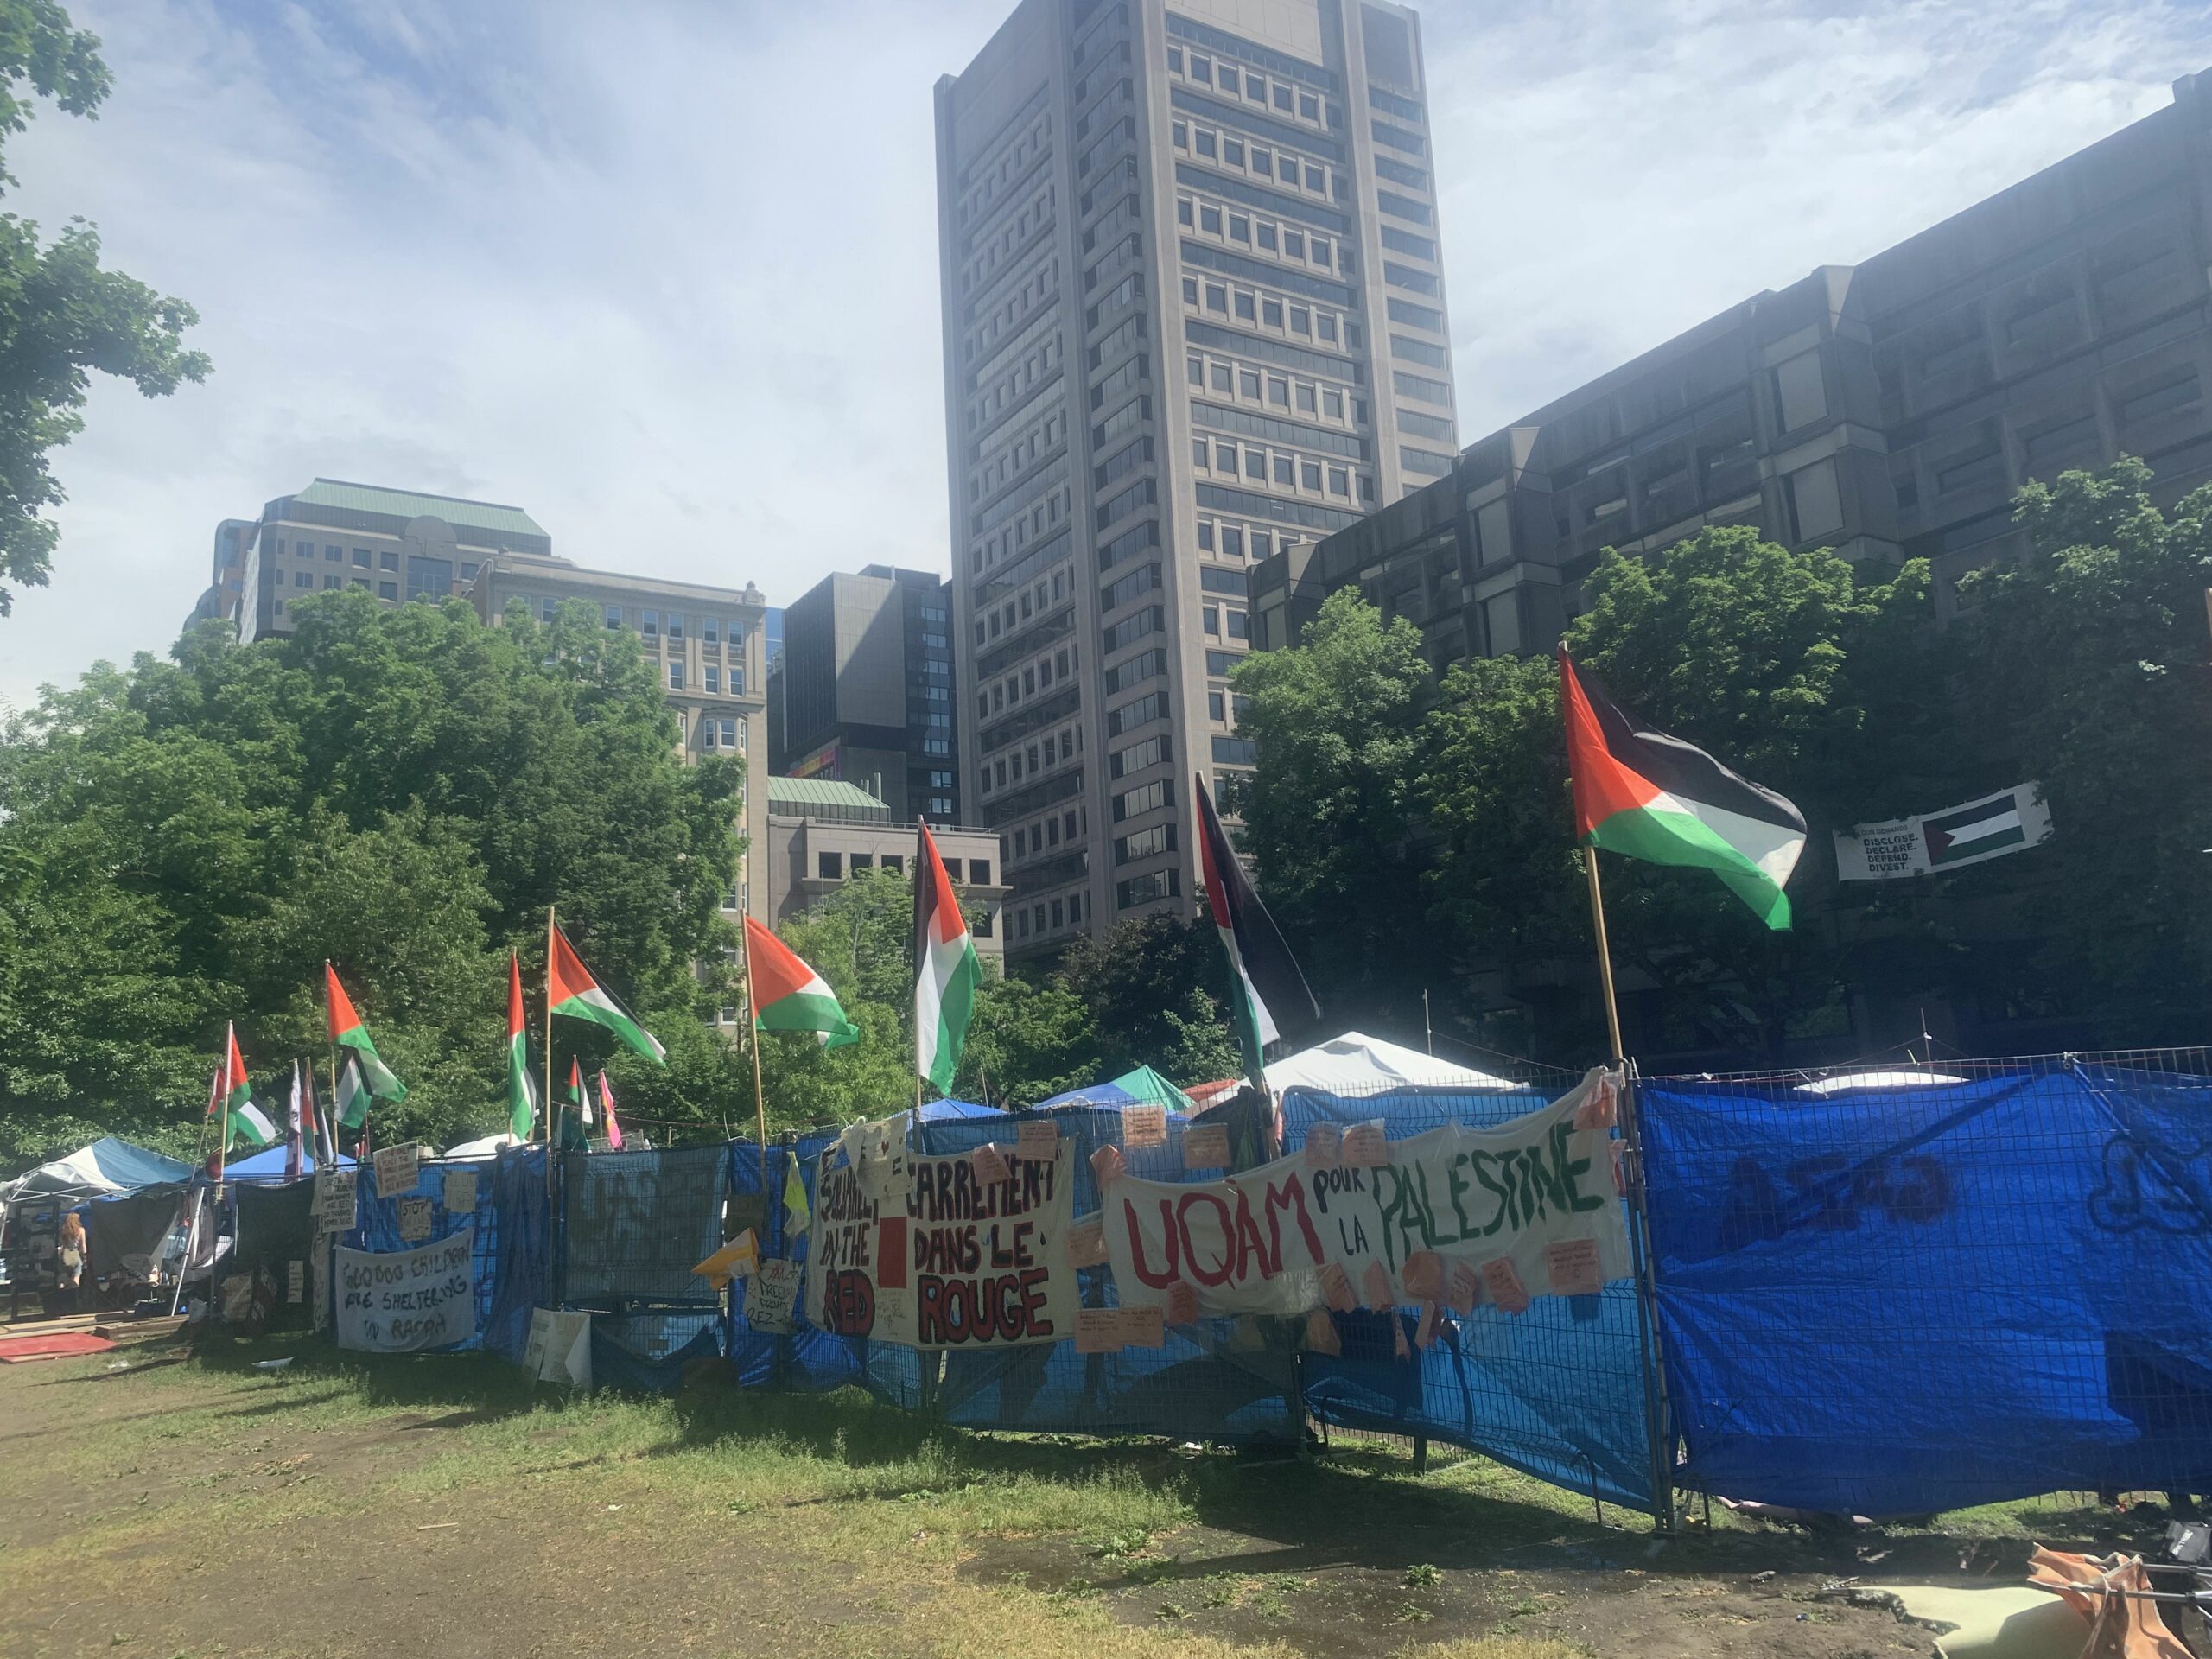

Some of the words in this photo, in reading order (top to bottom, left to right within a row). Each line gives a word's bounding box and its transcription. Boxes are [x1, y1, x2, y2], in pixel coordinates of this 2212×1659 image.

[1866, 842, 1916, 855] DECLARE.
[1869, 862, 1909, 872] DIVEST.
[1313, 1166, 1366, 1213] POUR
[1372, 1120, 1605, 1274] PALESTINE
[820, 1226, 839, 1267] IN
[842, 1222, 870, 1267] THE
[914, 1224, 982, 1274] DANS
[991, 1221, 1033, 1268] LE
[1339, 1213, 1370, 1256] LA
[823, 1268, 876, 1339] RED
[918, 1266, 1054, 1344] ROUGE
